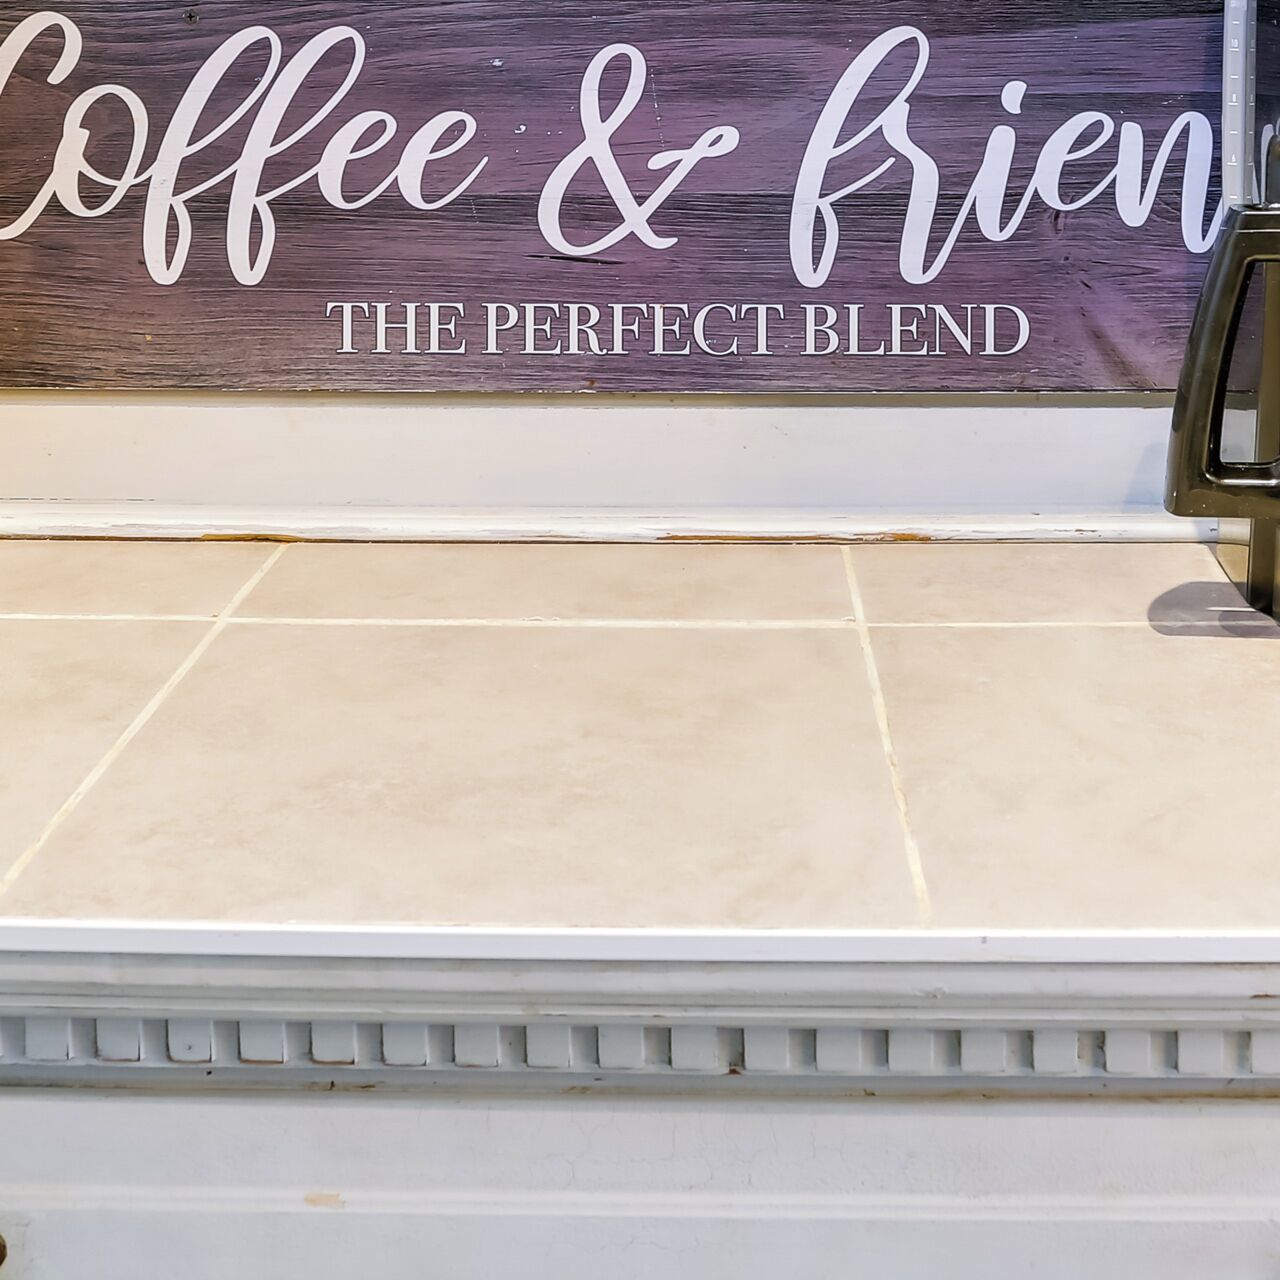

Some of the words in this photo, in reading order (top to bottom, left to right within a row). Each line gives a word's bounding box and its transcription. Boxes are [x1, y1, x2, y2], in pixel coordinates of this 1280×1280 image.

[537, 42, 741, 257] &
[324, 301, 467, 356] THE
[481, 301, 785, 358] PERFECT
[801, 302, 1032, 358] BLEND
